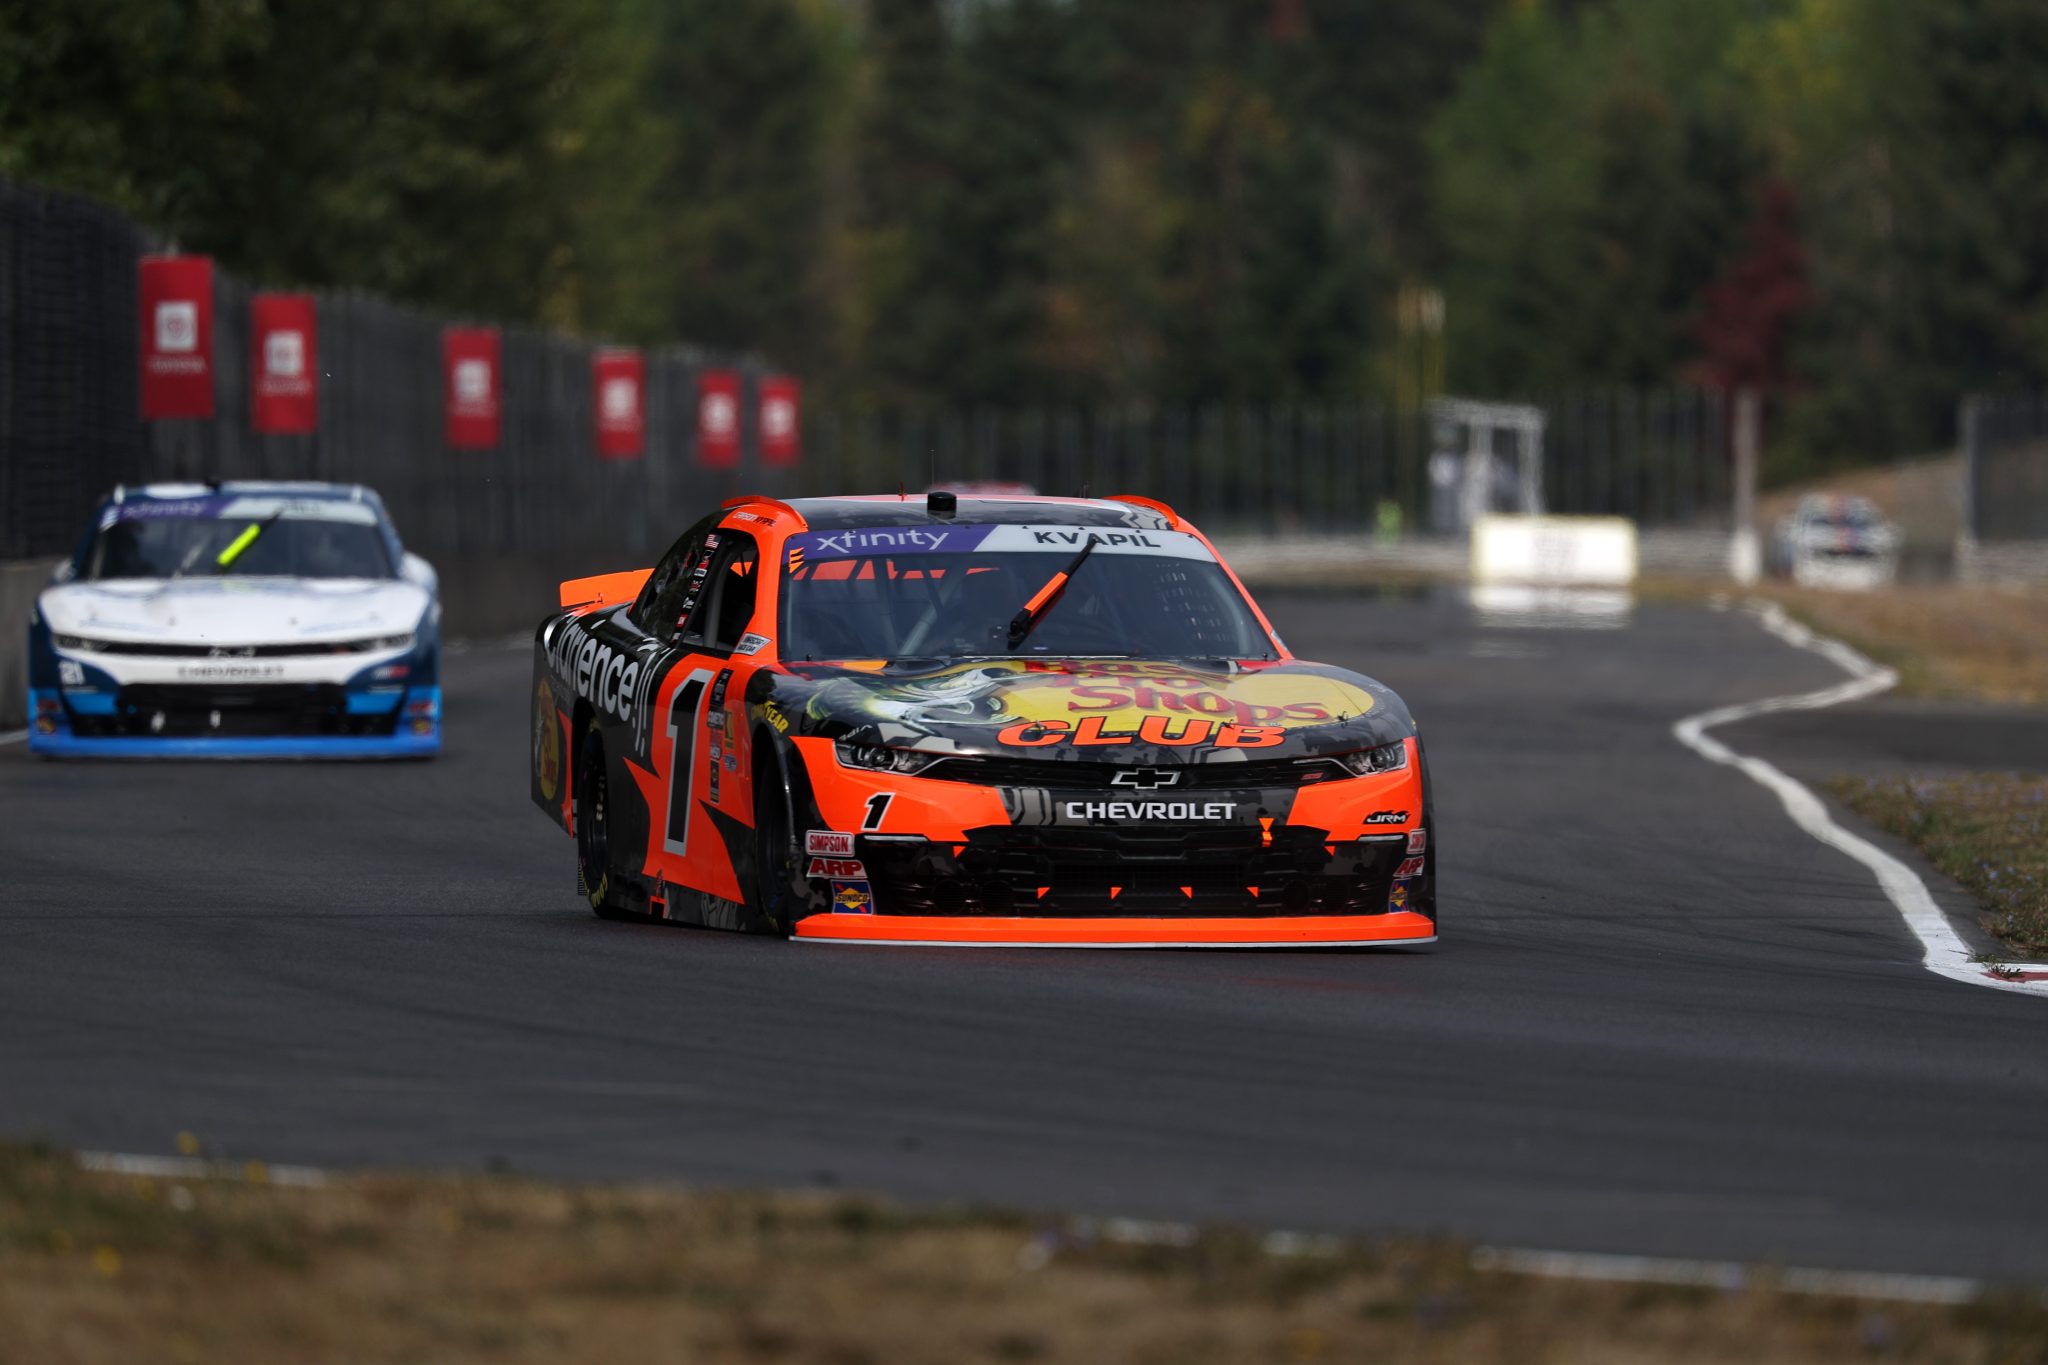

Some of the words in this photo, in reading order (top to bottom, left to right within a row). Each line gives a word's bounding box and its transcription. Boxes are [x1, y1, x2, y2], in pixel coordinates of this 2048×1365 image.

[816, 529, 950, 554] xfinity
[1033, 531, 1161, 549] KVAPIL
[1067, 684, 1334, 727] Shops
[996, 714, 1287, 748] CLUB
[664, 667, 716, 857] 1
[861, 792, 896, 831] 1
[1066, 802, 1237, 821] CHEVROLET
[1366, 814, 1407, 824] JRM
[809, 834, 850, 852] SIMPSON
[810, 858, 863, 876] ARP
[837, 893, 870, 903] SUNOCO
